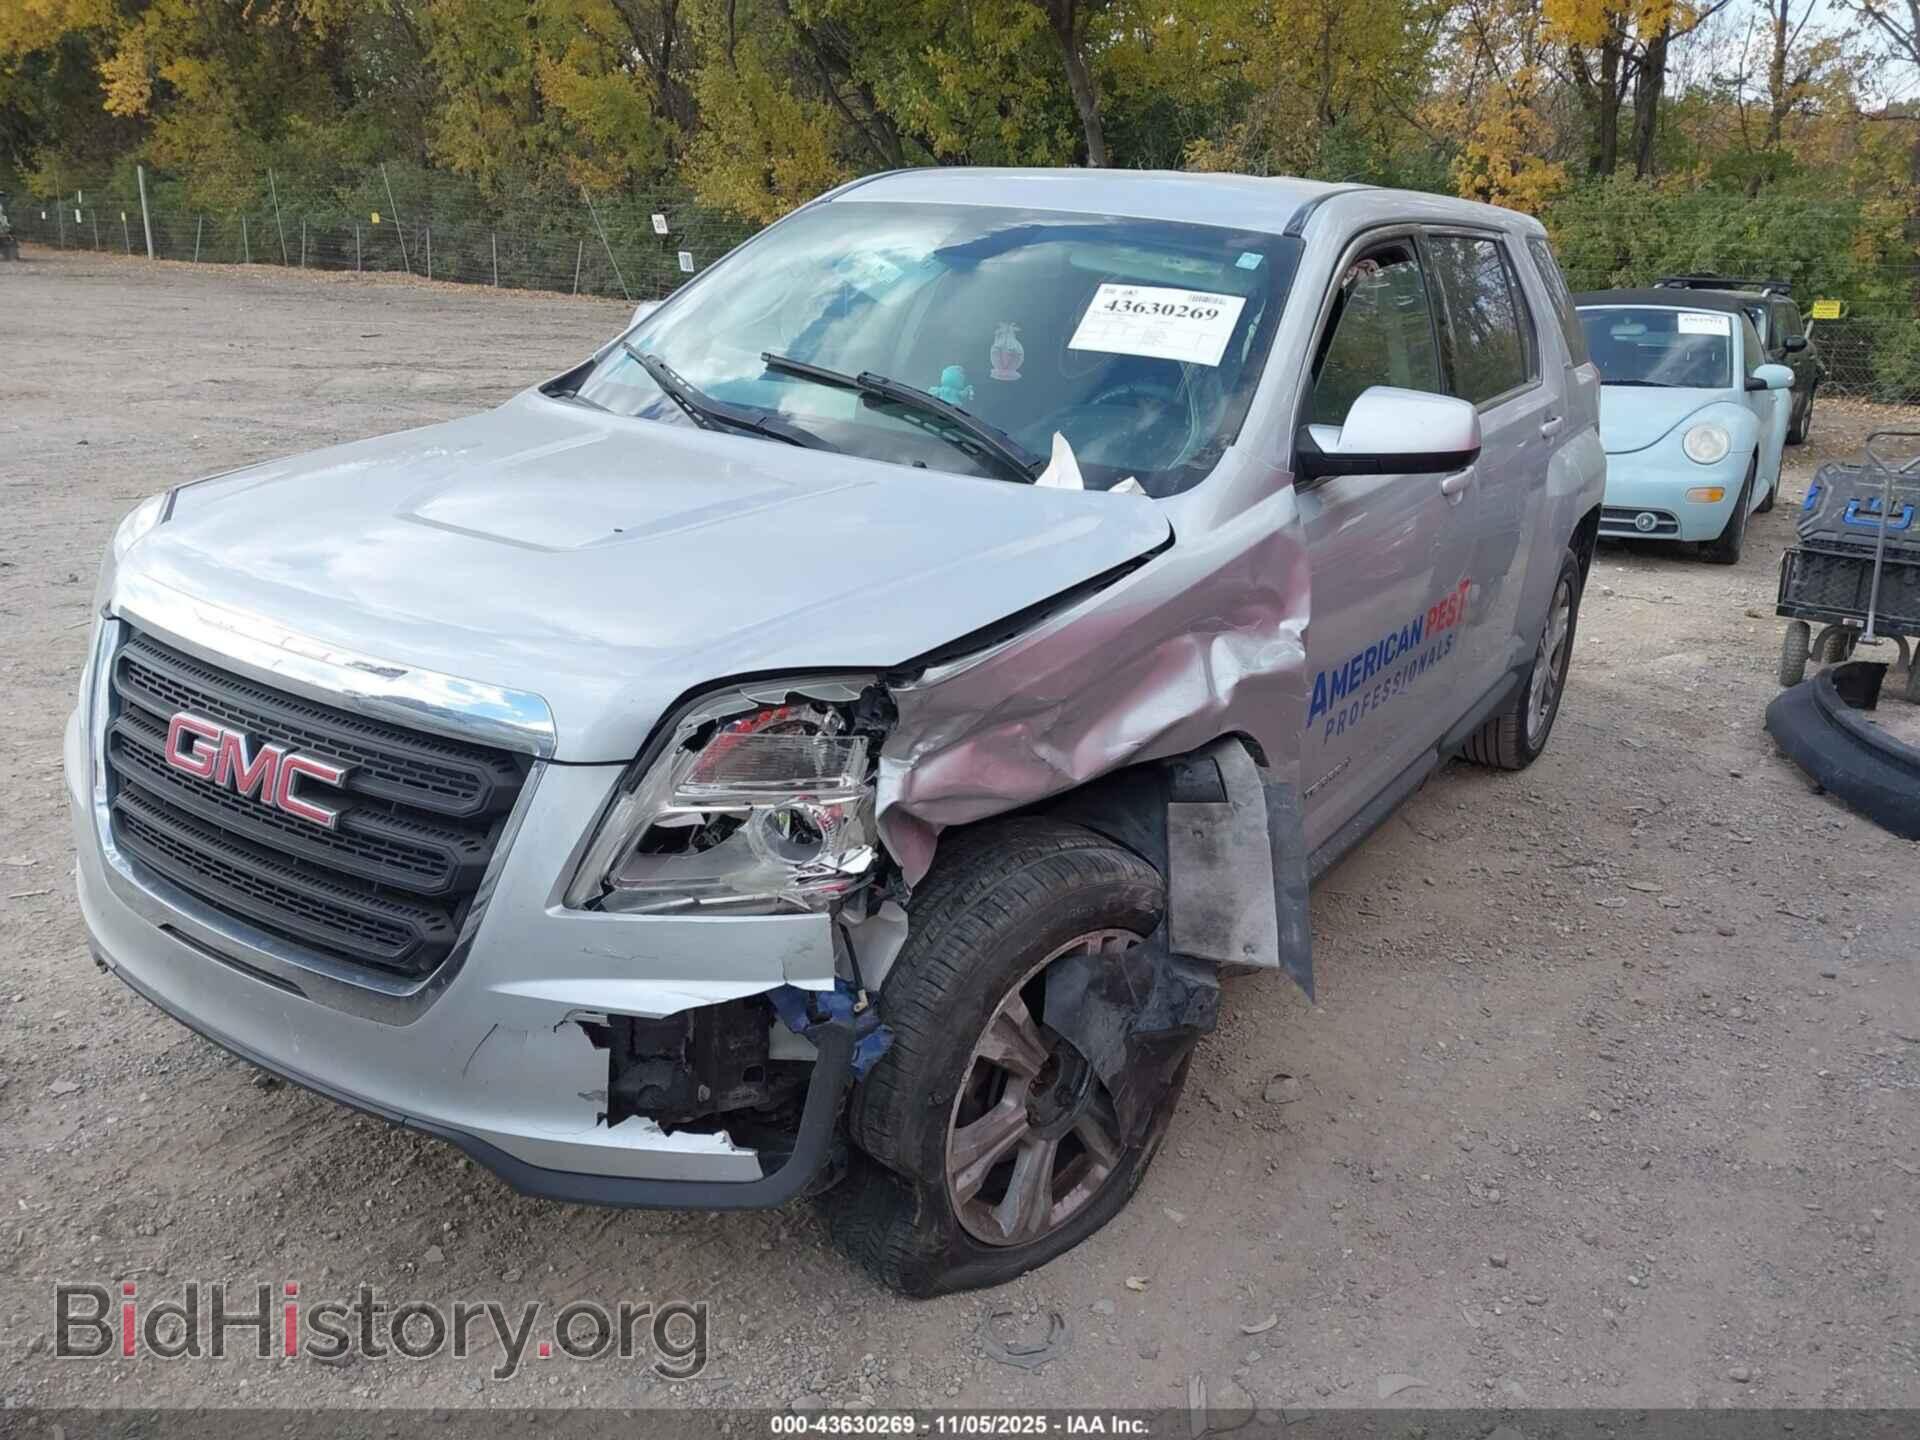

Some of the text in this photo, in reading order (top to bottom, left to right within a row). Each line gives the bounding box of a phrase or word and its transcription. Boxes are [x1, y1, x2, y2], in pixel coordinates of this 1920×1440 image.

[1103, 299, 1219, 321] 43630269
[1306, 577, 1472, 729] AMERICAN PEST
[1324, 633, 1454, 745] PROFESSIONALS
[165, 711, 346, 830] GMC
